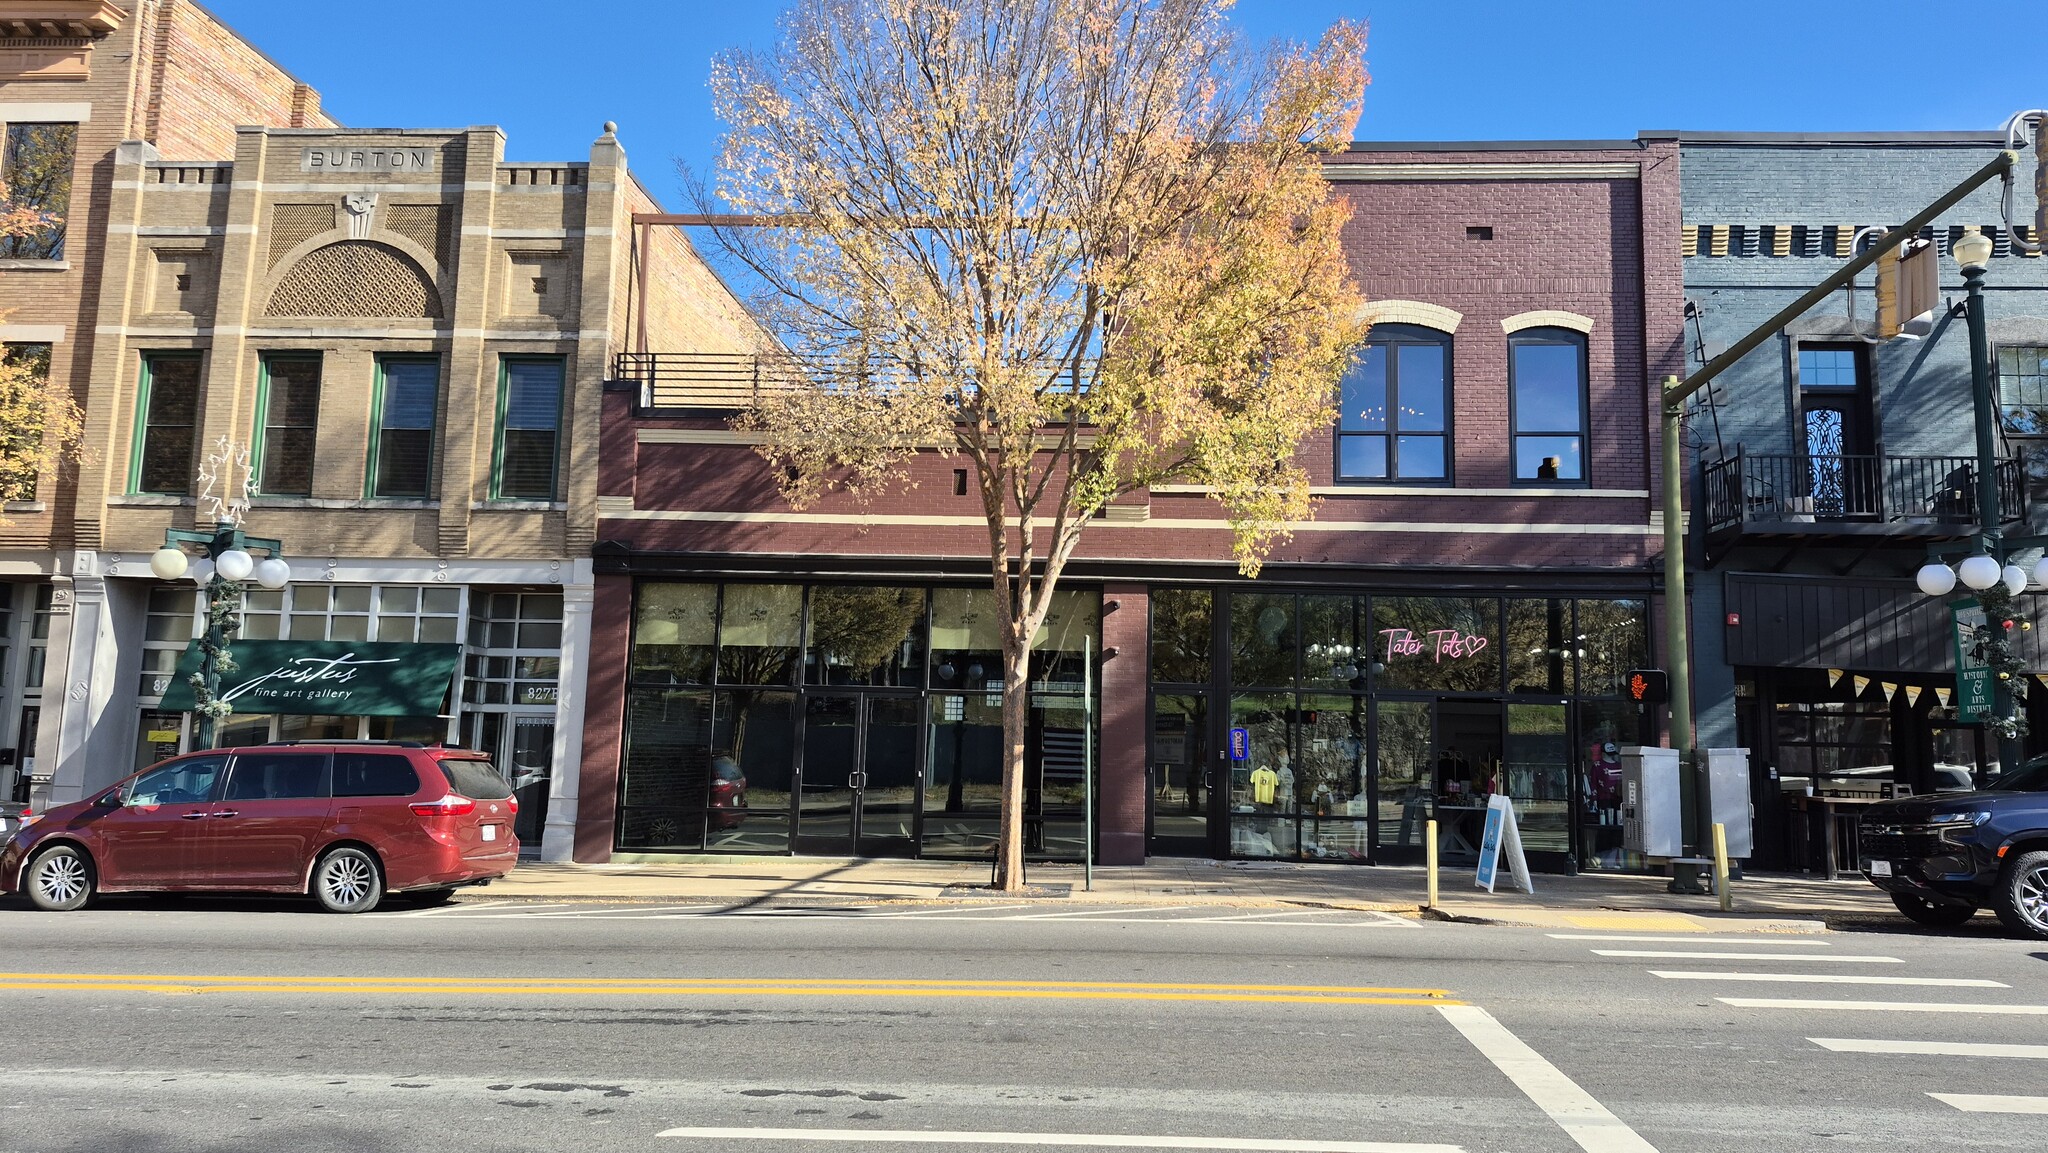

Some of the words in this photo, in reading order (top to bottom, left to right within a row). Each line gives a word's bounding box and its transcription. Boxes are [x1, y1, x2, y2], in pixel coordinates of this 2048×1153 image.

[310, 151, 425, 167] BURTON
[1379, 629, 1424, 663] Tater
[1427, 630, 1465, 663] Tots
[222, 653, 400, 701] justus
[254, 687, 278, 698] fine
[283, 689, 302, 698] art
[307, 688, 352, 700] gallery
[1973, 680, 1982, 695] &
[1972, 695, 1985, 703] ARTS
[1967, 704, 1991, 714] DISTRICT
[1235, 731, 1243, 757] OPEN
